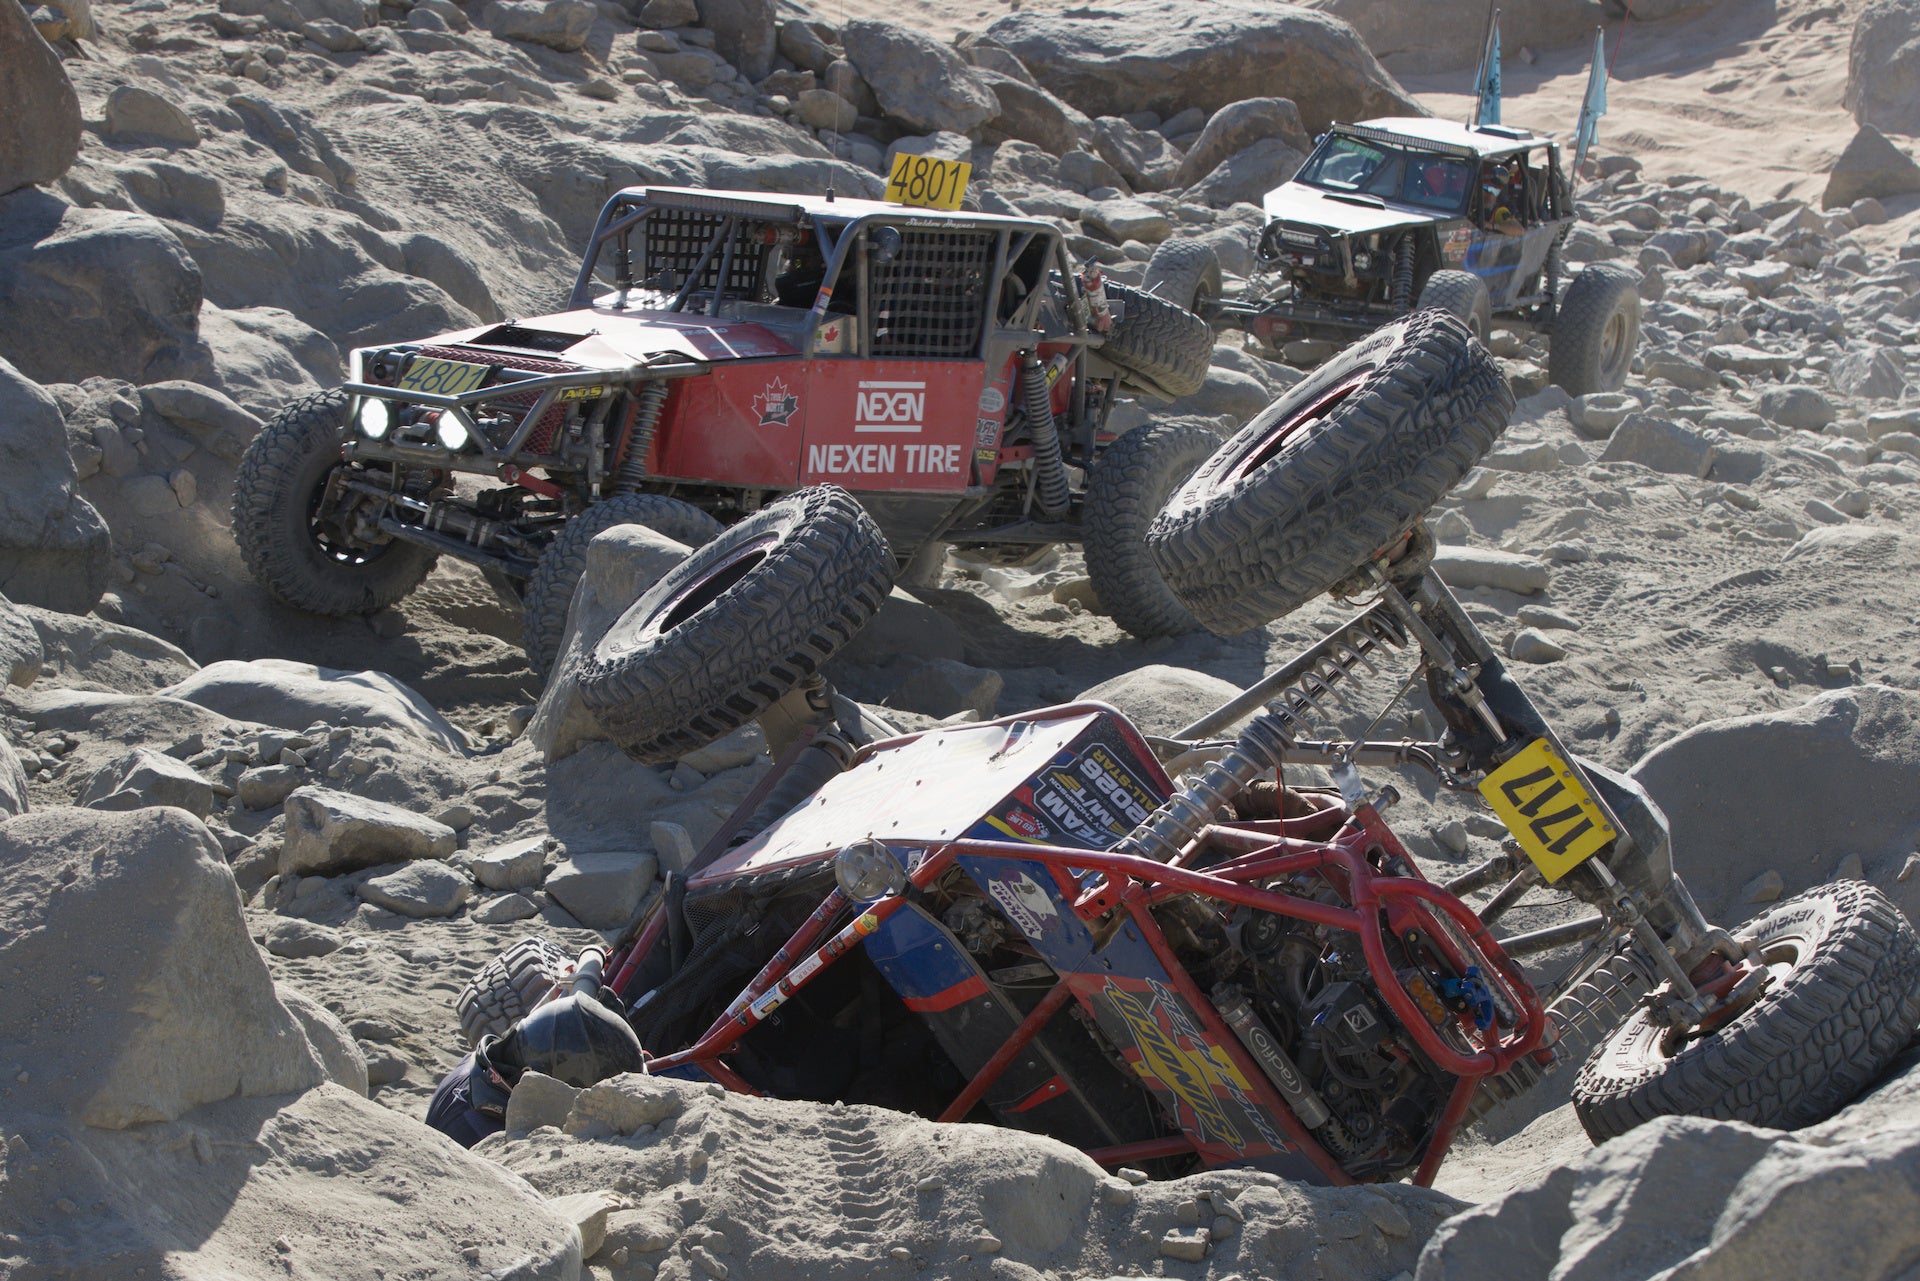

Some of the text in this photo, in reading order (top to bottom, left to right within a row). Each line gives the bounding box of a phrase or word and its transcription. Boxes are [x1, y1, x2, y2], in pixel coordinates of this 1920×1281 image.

[892, 156, 961, 203] 4801
[404, 360, 485, 395] 4801
[563, 386, 603, 399] ADS
[855, 392, 925, 422] NEXEN
[808, 445, 961, 473] NEXEN TIRE
[1048, 777, 1091, 821] THOMPSON
[1078, 756, 1149, 824] 2026
[1091, 748, 1157, 811] ALL-STAR
[1007, 814, 1023, 825] LINE
[1021, 822, 1035, 832] RED
[1040, 789, 1105, 845] TEAM
[1069, 785, 1115, 827] M/T
[1500, 765, 1594, 855] 1717
[990, 884, 1036, 936] Yukon
[1757, 908, 1815, 938] MICKEY
[1118, 998, 1235, 1137] SUNOCO
[1146, 977, 1290, 1154] RACE FUELS
[1254, 1031, 1298, 1088] radflo
